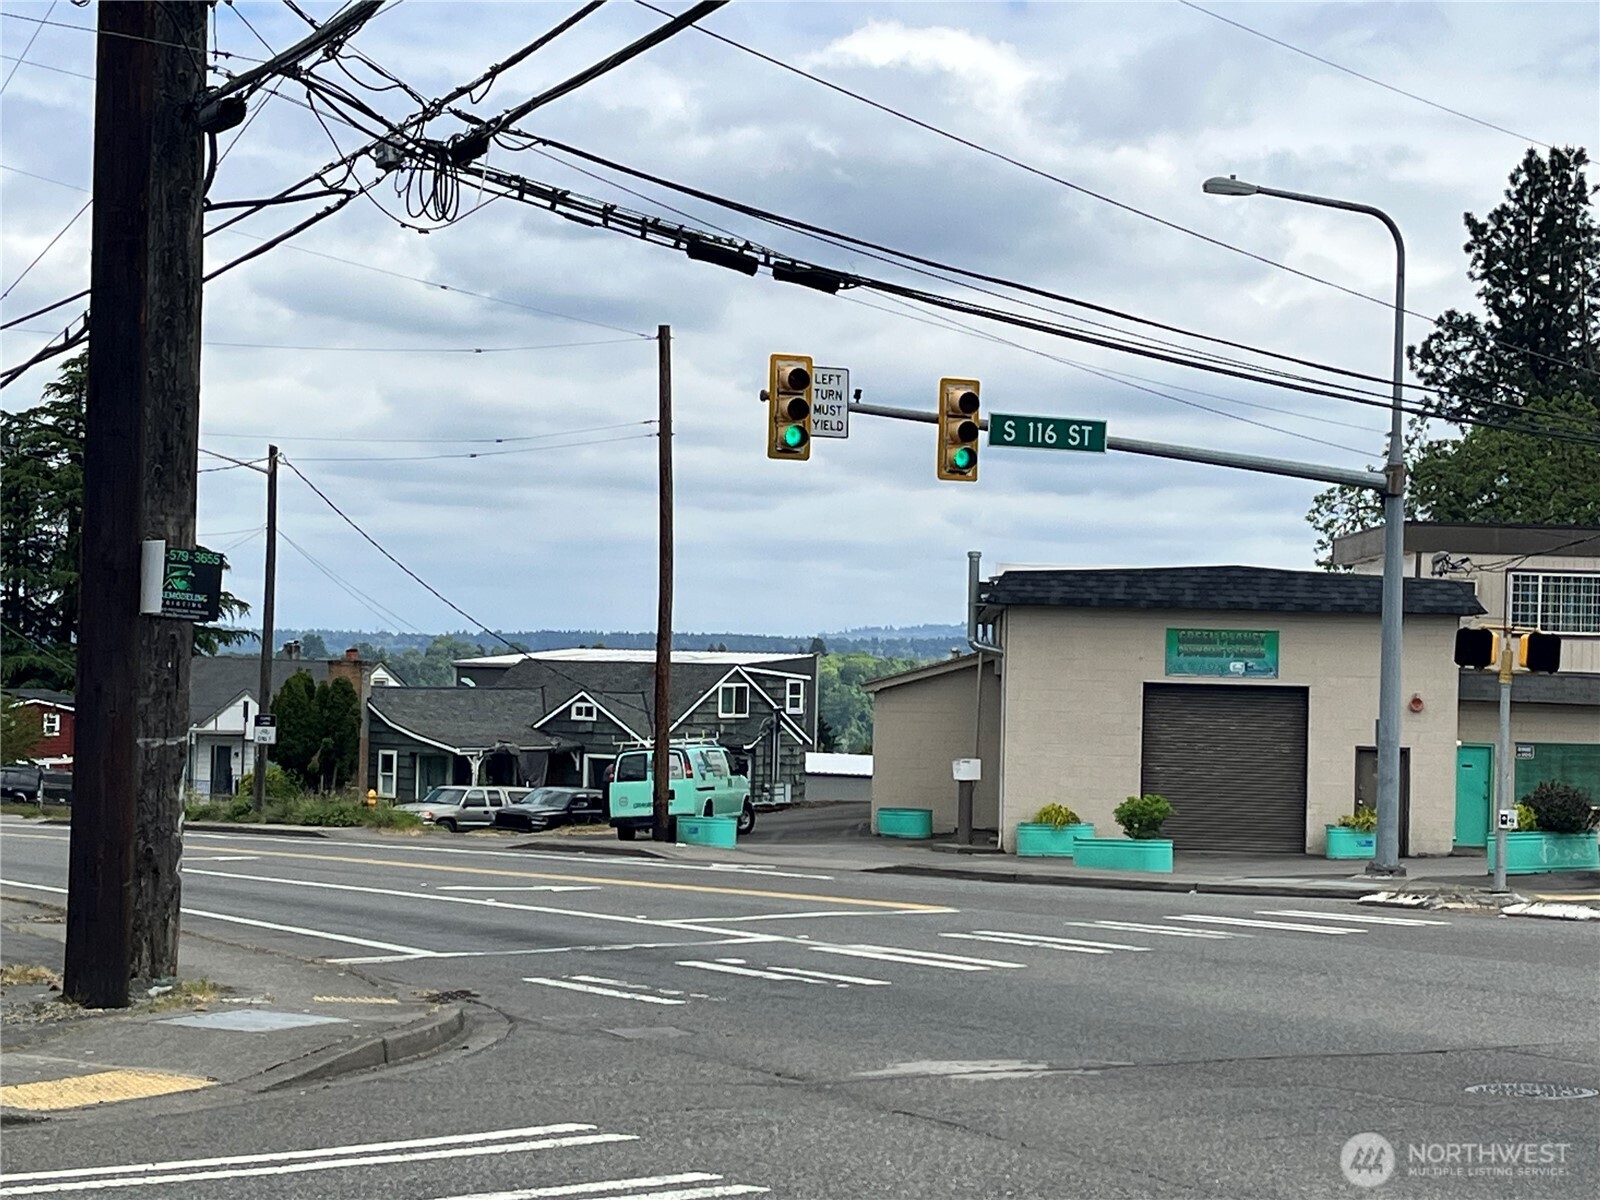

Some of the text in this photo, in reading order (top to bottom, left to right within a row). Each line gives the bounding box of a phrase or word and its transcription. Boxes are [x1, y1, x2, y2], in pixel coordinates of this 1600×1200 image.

[815, 373, 842, 385] LEFT
[814, 388, 843, 401] TURN
[813, 404, 842, 416] MUST
[812, 418, 844, 431] YIELD
[1003, 420, 1093, 446] S 116 ST
